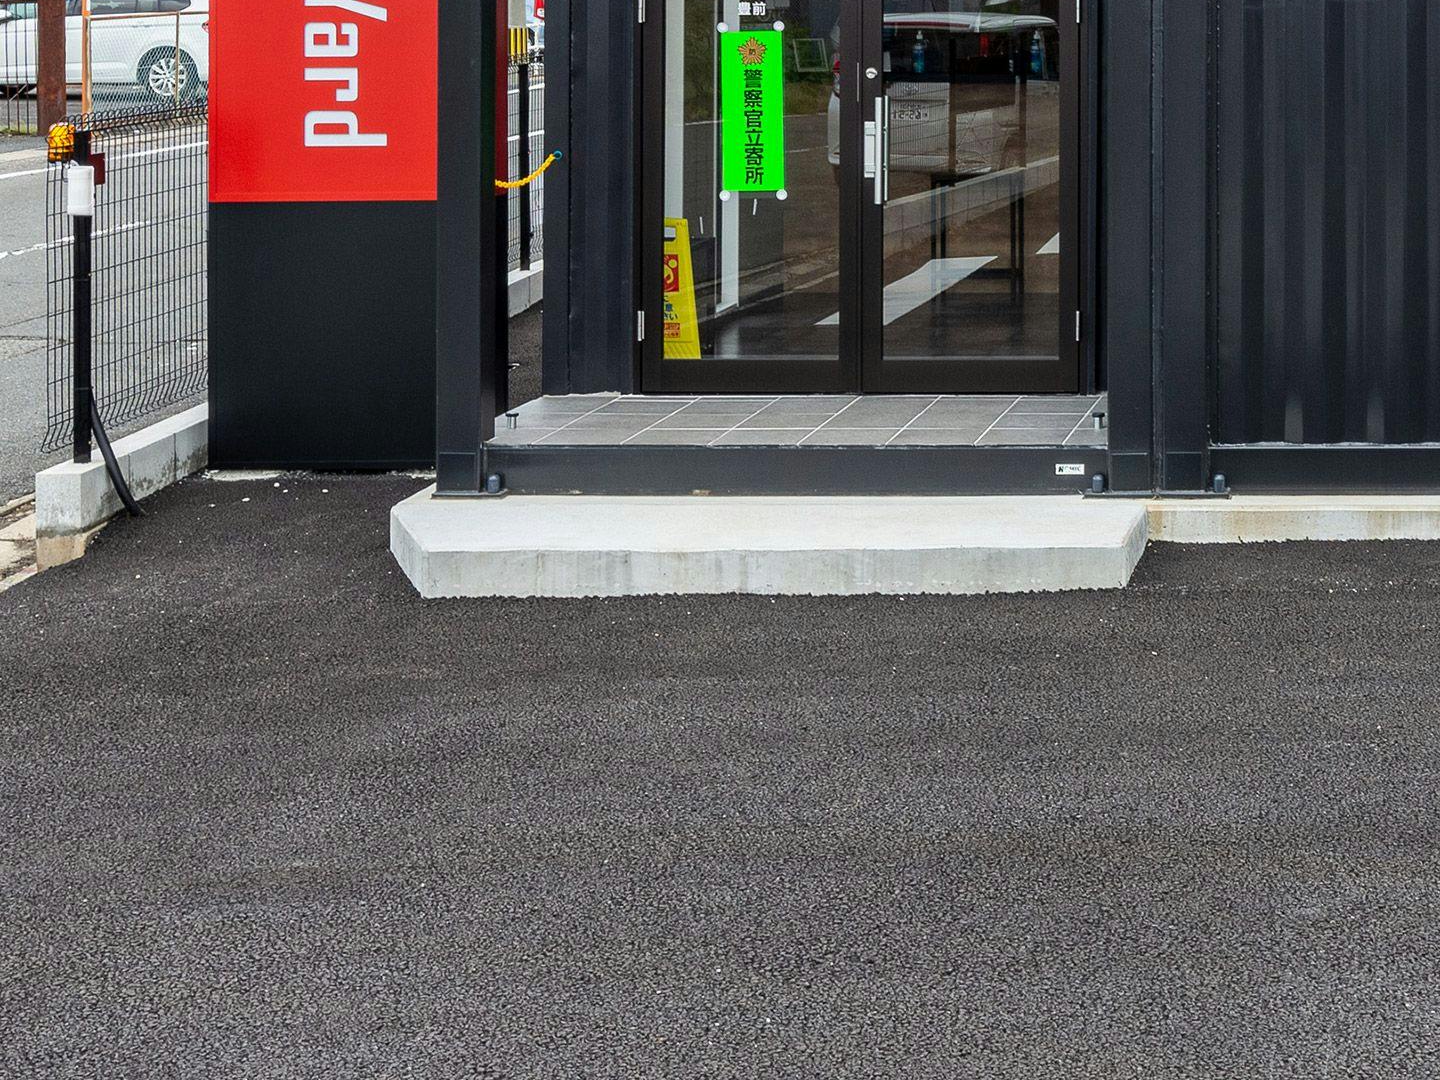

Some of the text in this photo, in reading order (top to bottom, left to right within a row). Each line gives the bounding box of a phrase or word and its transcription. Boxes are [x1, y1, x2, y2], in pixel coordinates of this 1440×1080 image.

[743, 68, 764, 186] 警察官立寄所
